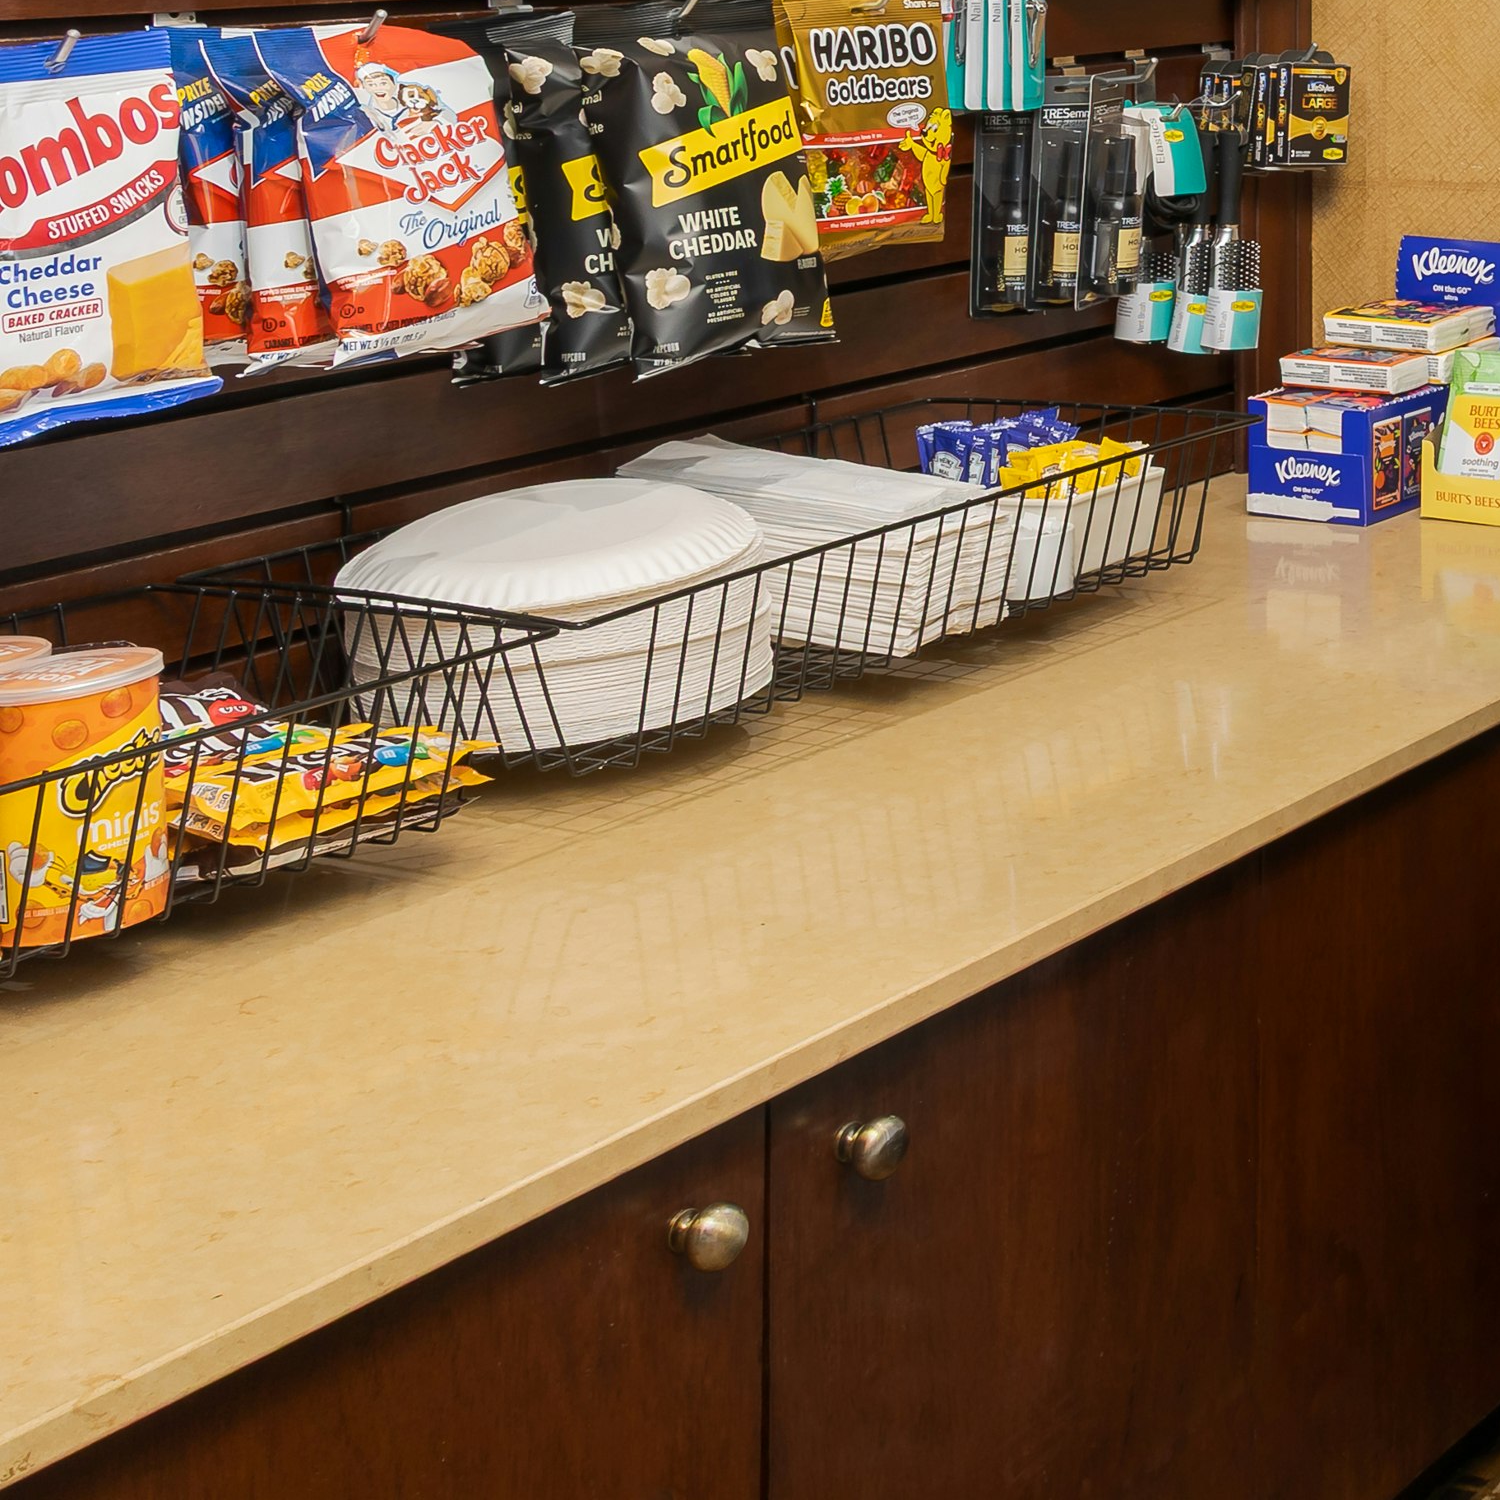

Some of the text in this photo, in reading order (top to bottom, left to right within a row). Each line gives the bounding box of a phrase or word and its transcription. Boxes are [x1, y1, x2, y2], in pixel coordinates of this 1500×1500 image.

[810, 21, 938, 74] HARIBO
[825, 75, 933, 107] Goldbears
[373, 114, 490, 167] Cracker
[663, 116, 795, 189] Smartfood
[402, 148, 484, 206] Jack
[47, 168, 165, 239] STUFFED SNACKS
[677, 206, 742, 233] WHITE
[400, 206, 502, 250] The Original
[668, 229, 758, 262] CHEDDAR
[1411, 247, 1496, 283] Kleenex
[7, 279, 95, 309] Cheese
[8, 302, 100, 328] BAKED CRACKER
[1460, 456, 1500, 471] soothing
